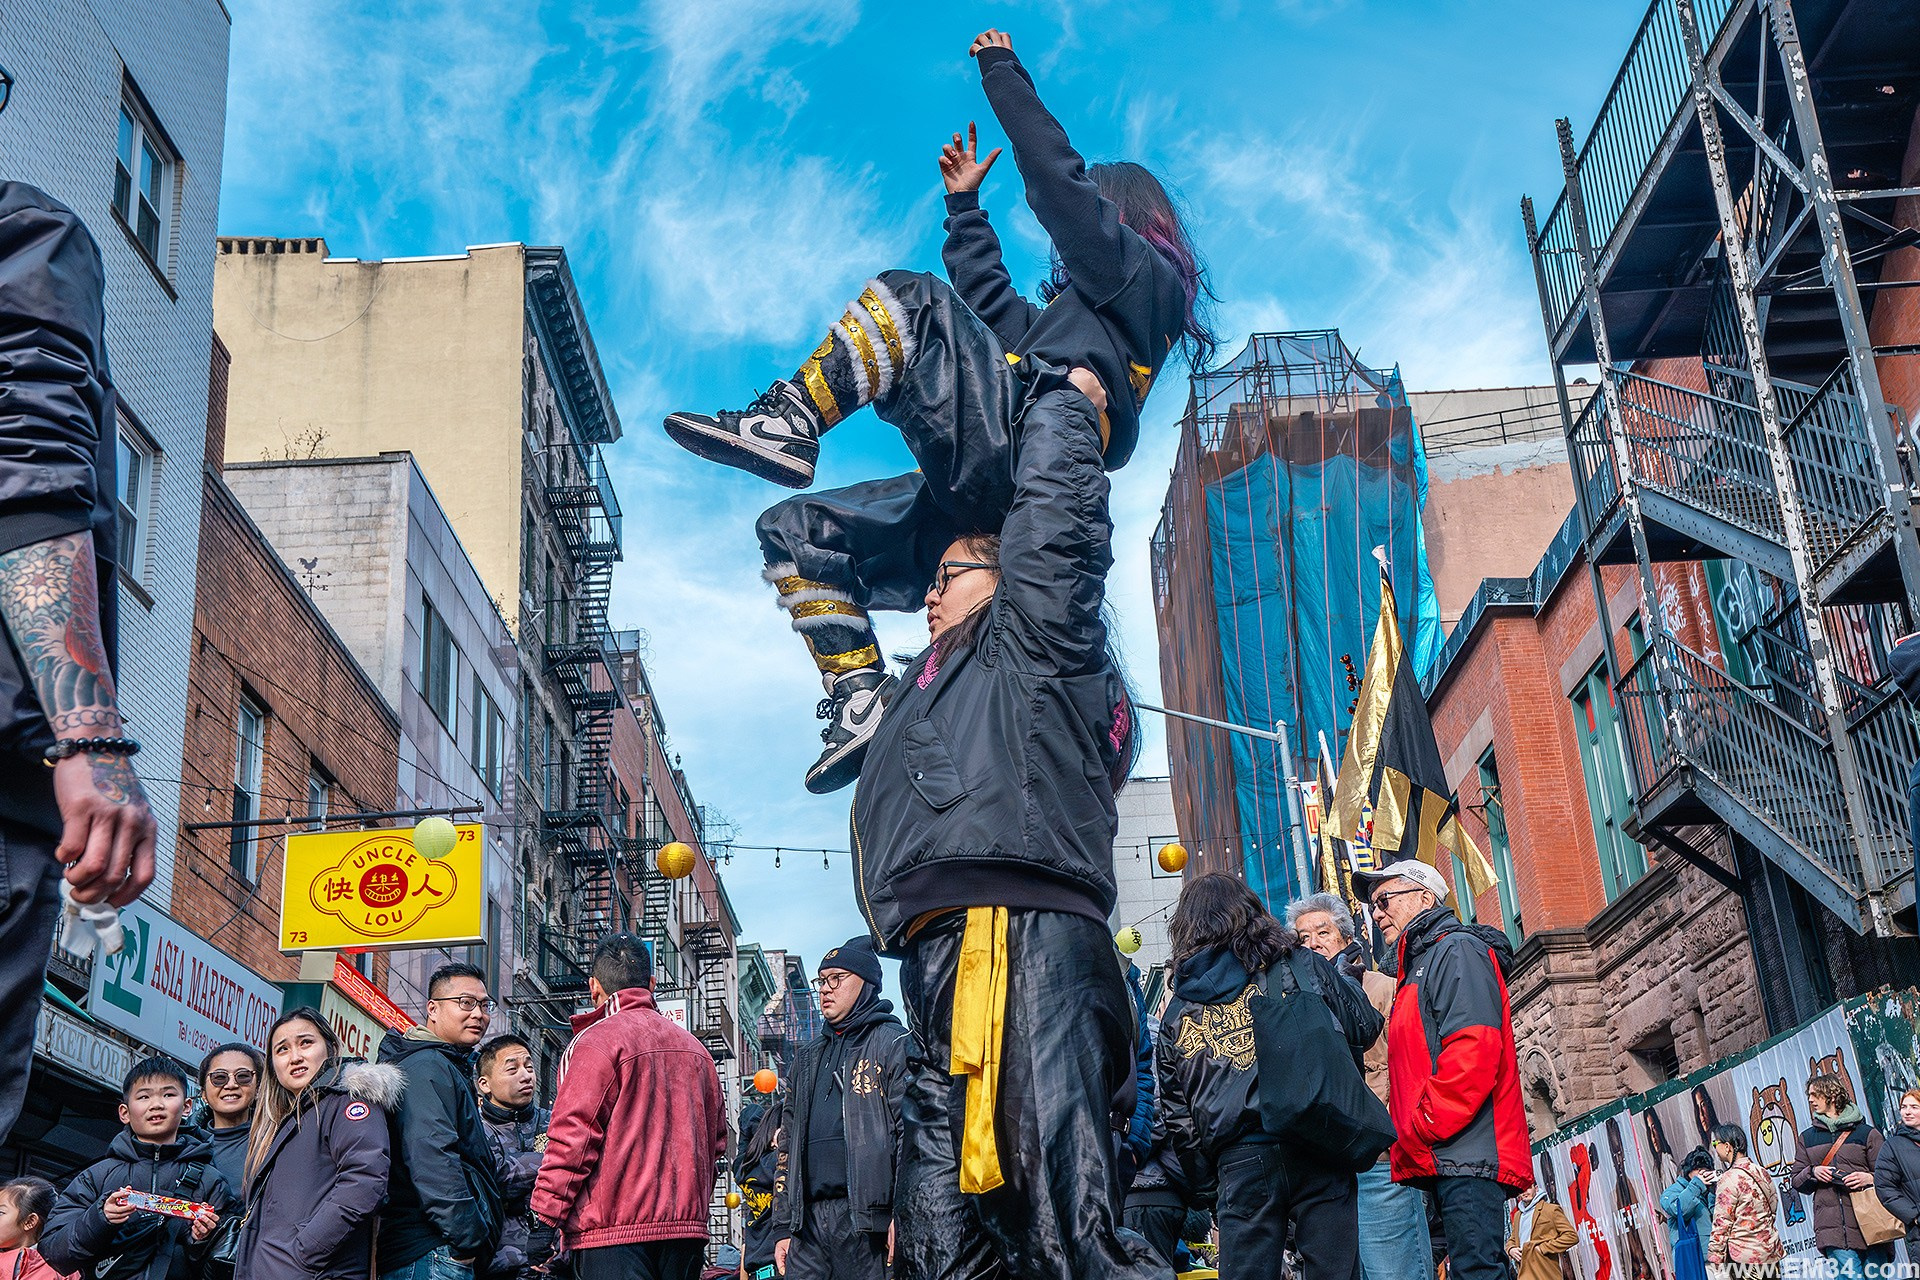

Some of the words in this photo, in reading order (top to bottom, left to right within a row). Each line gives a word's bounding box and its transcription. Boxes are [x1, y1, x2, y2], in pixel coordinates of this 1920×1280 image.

[457, 830, 475, 842] 73
[352, 845, 418, 869] UNCLE
[364, 909, 403, 927] LOU
[289, 931, 308, 943] 73
[151, 936, 185, 1003] ASIA
[186, 956, 245, 1034] MARKET
[661, 1009, 684, 1021] 公司
